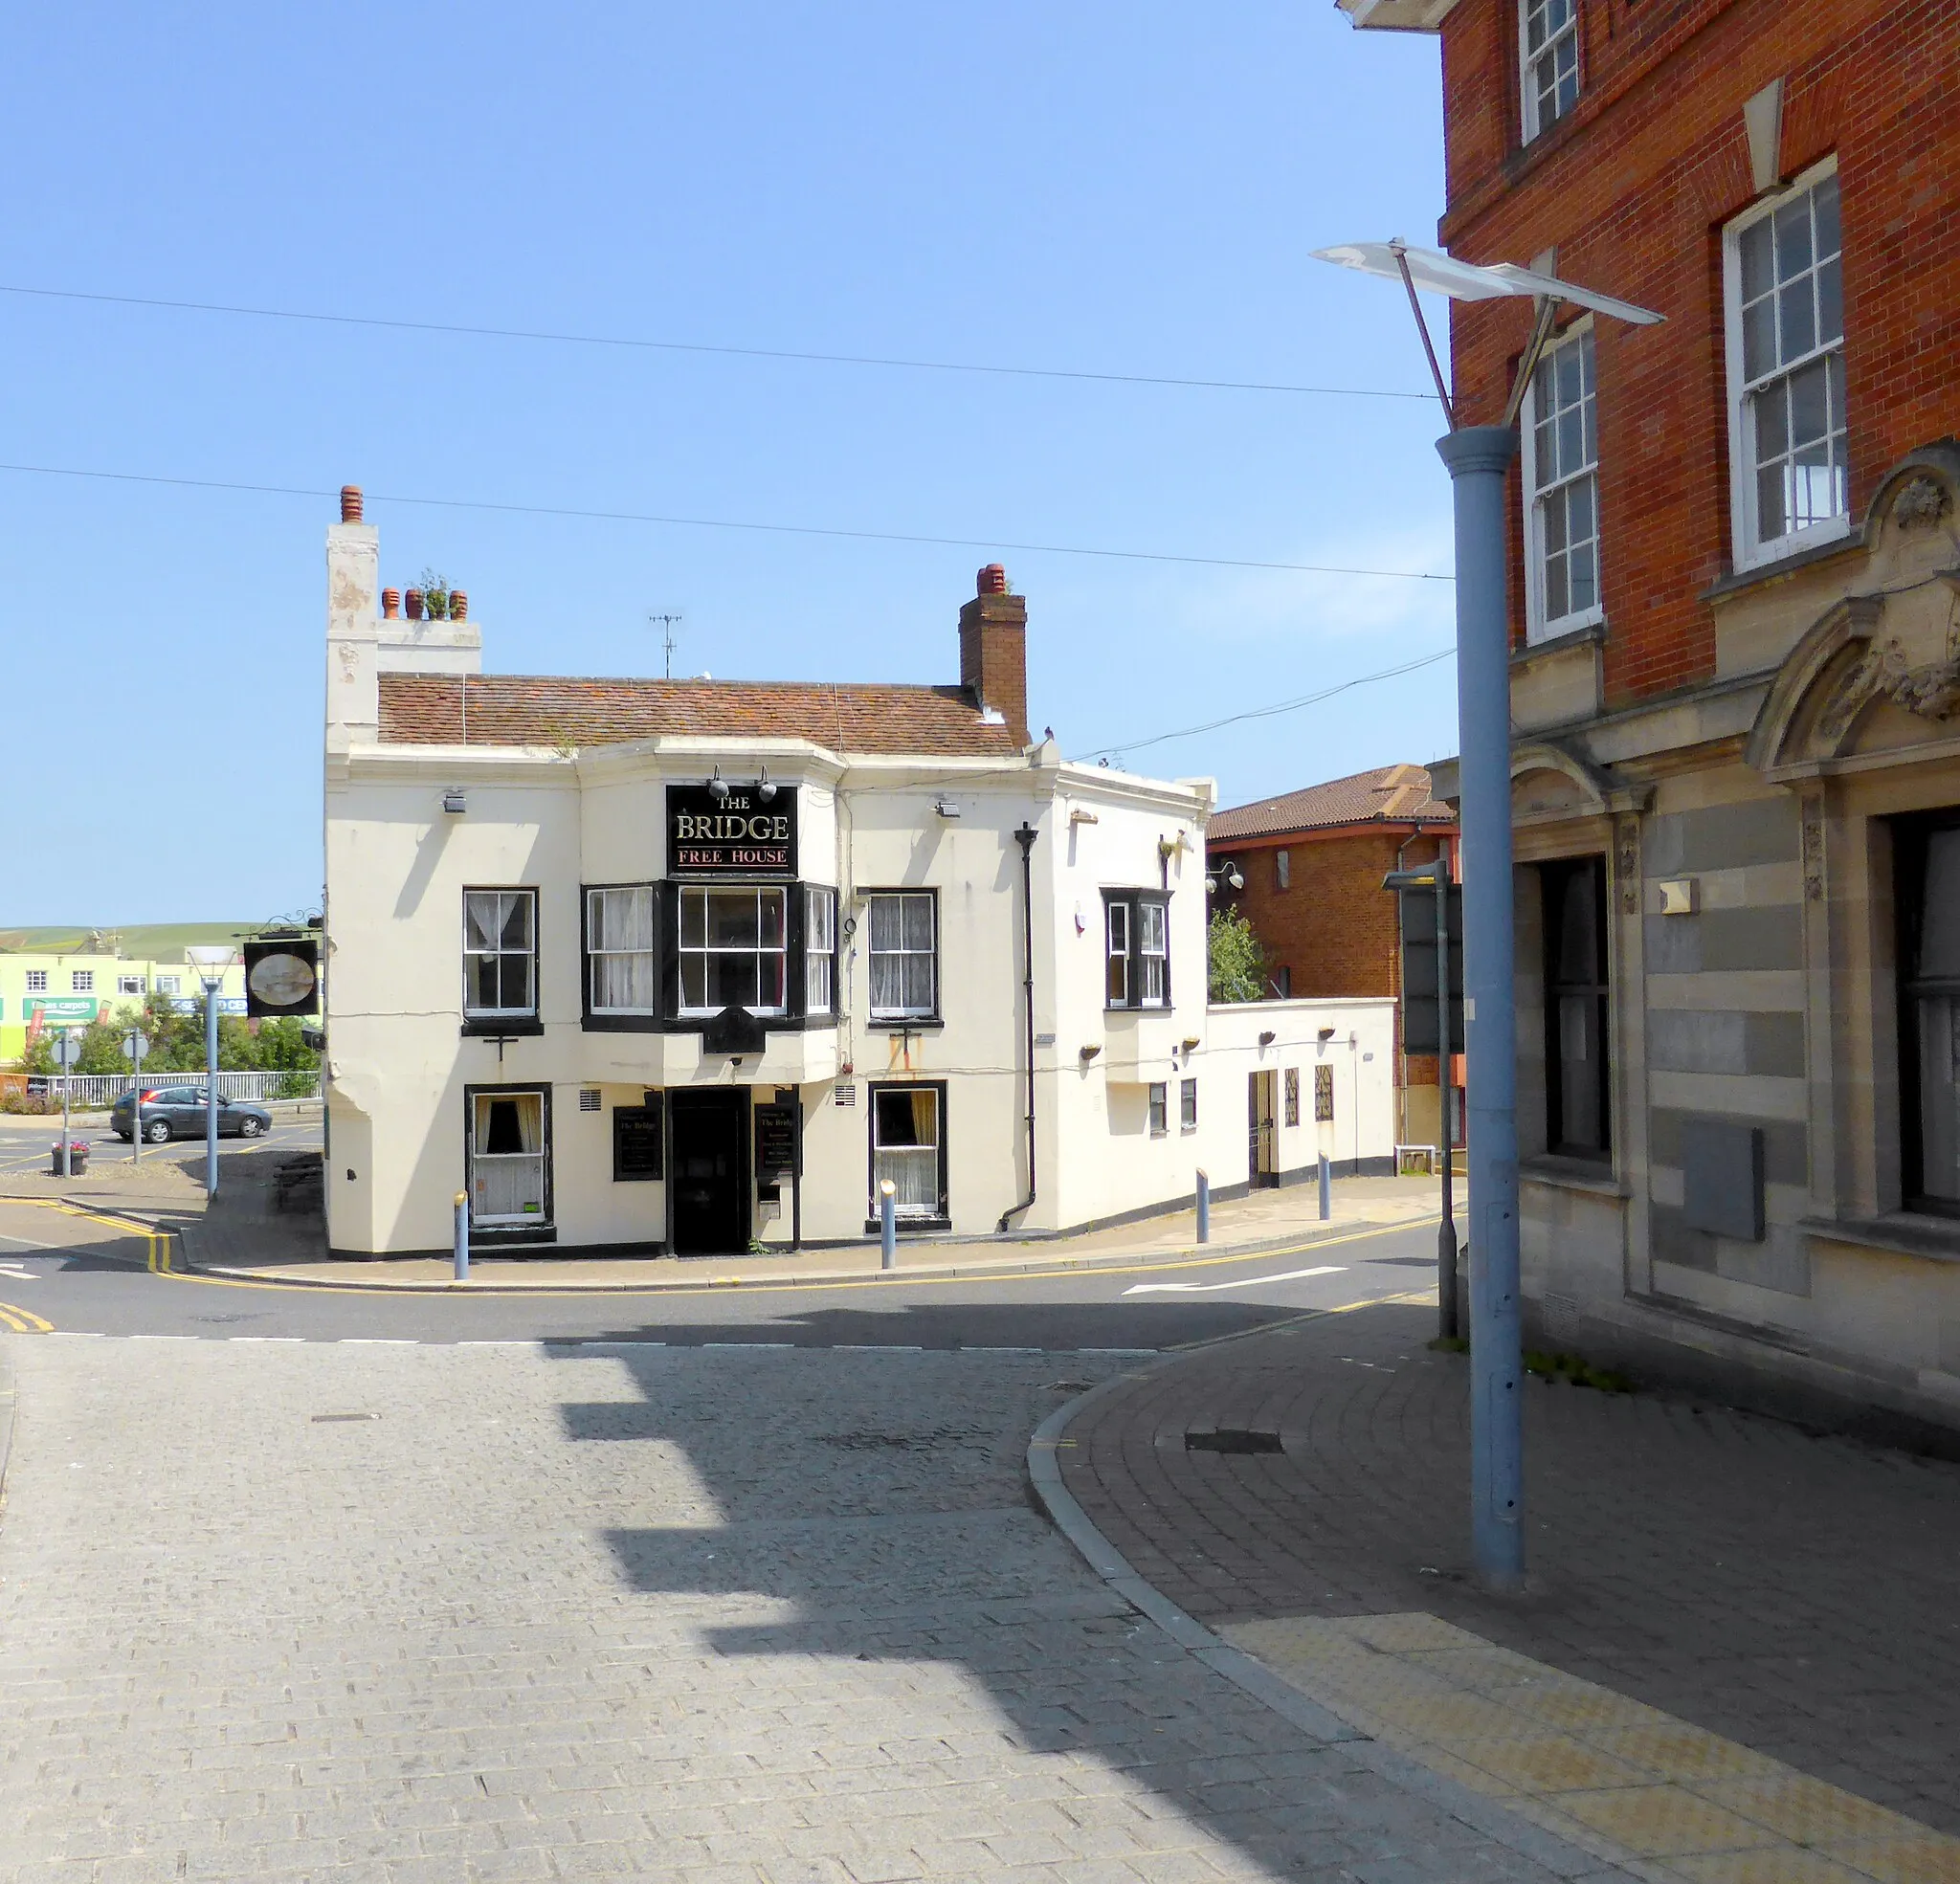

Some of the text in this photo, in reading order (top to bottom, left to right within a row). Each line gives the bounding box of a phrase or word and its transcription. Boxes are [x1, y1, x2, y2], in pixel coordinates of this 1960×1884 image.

[719, 797, 750, 809] THE
[677, 816, 789, 839] BRIDGE
[678, 850, 787, 863] FREE HOUSE
[58, 1001, 91, 1011] carpets
